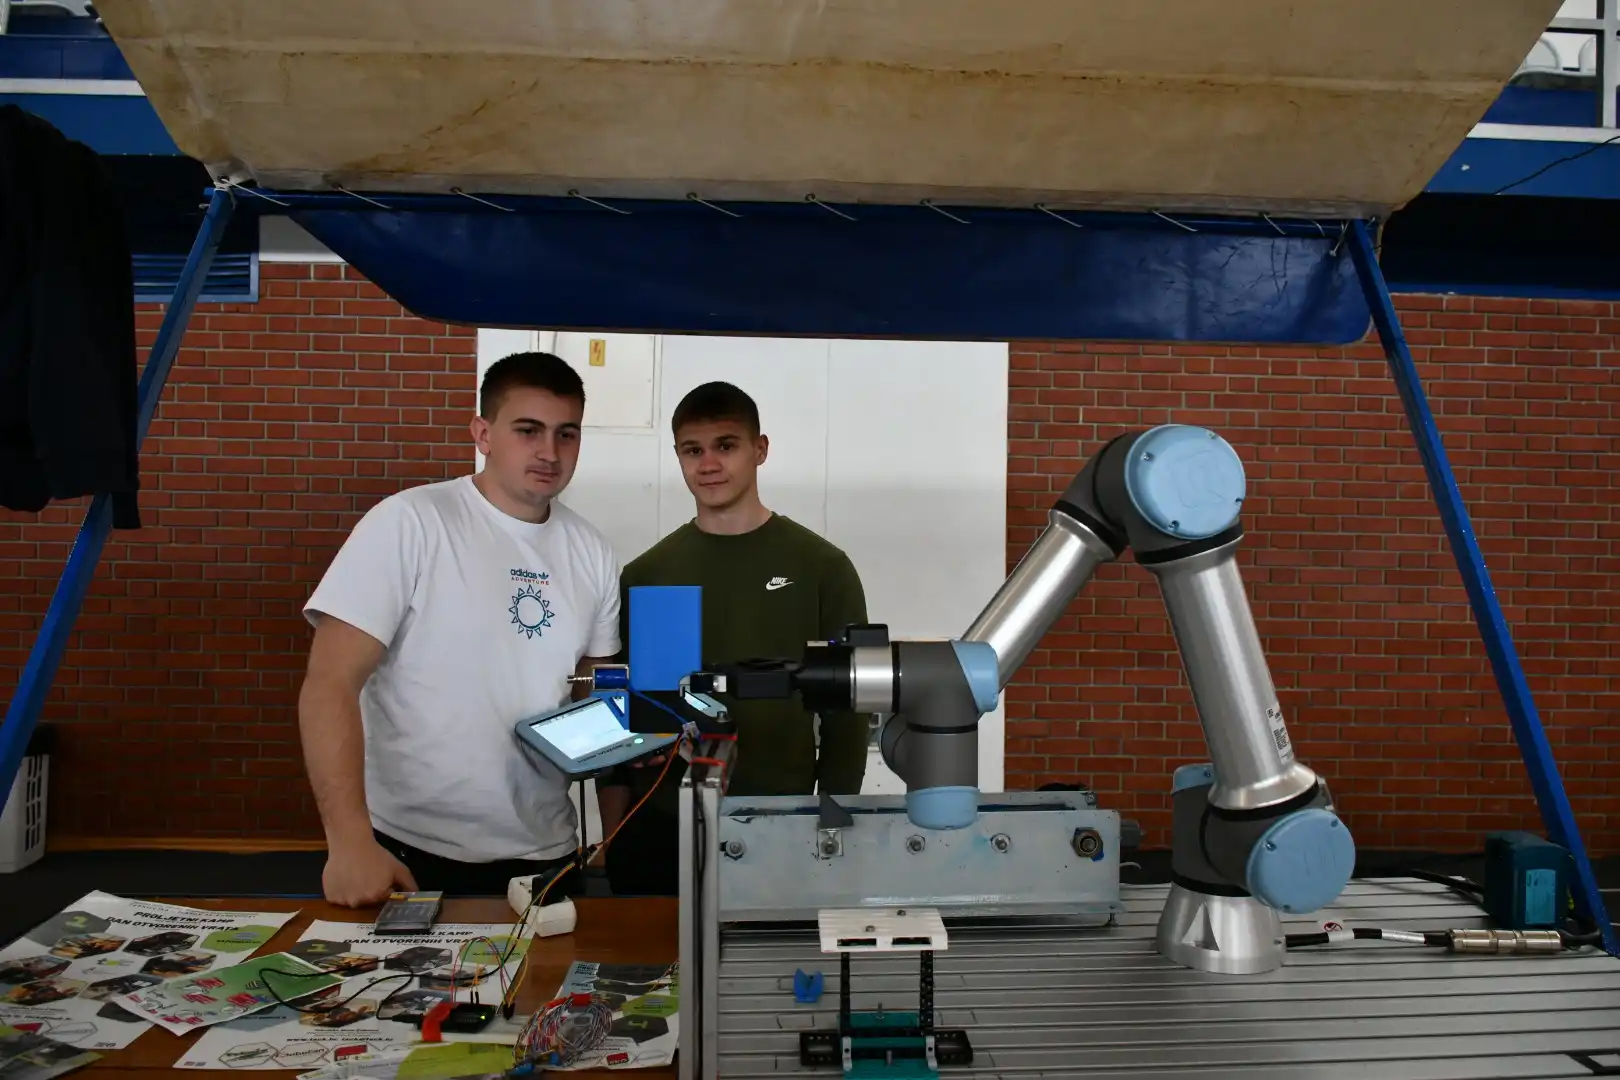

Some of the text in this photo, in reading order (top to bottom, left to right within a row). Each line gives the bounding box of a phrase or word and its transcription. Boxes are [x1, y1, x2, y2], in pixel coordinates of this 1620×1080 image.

[510, 569, 537, 579] adidas
[511, 576, 549, 585] ADVENTURE
[770, 577, 788, 585] NIKE
[134, 911, 200, 922] PROLJETNI
[105, 916, 132, 925] DAN
[132, 921, 200, 930] OTVORENIH
